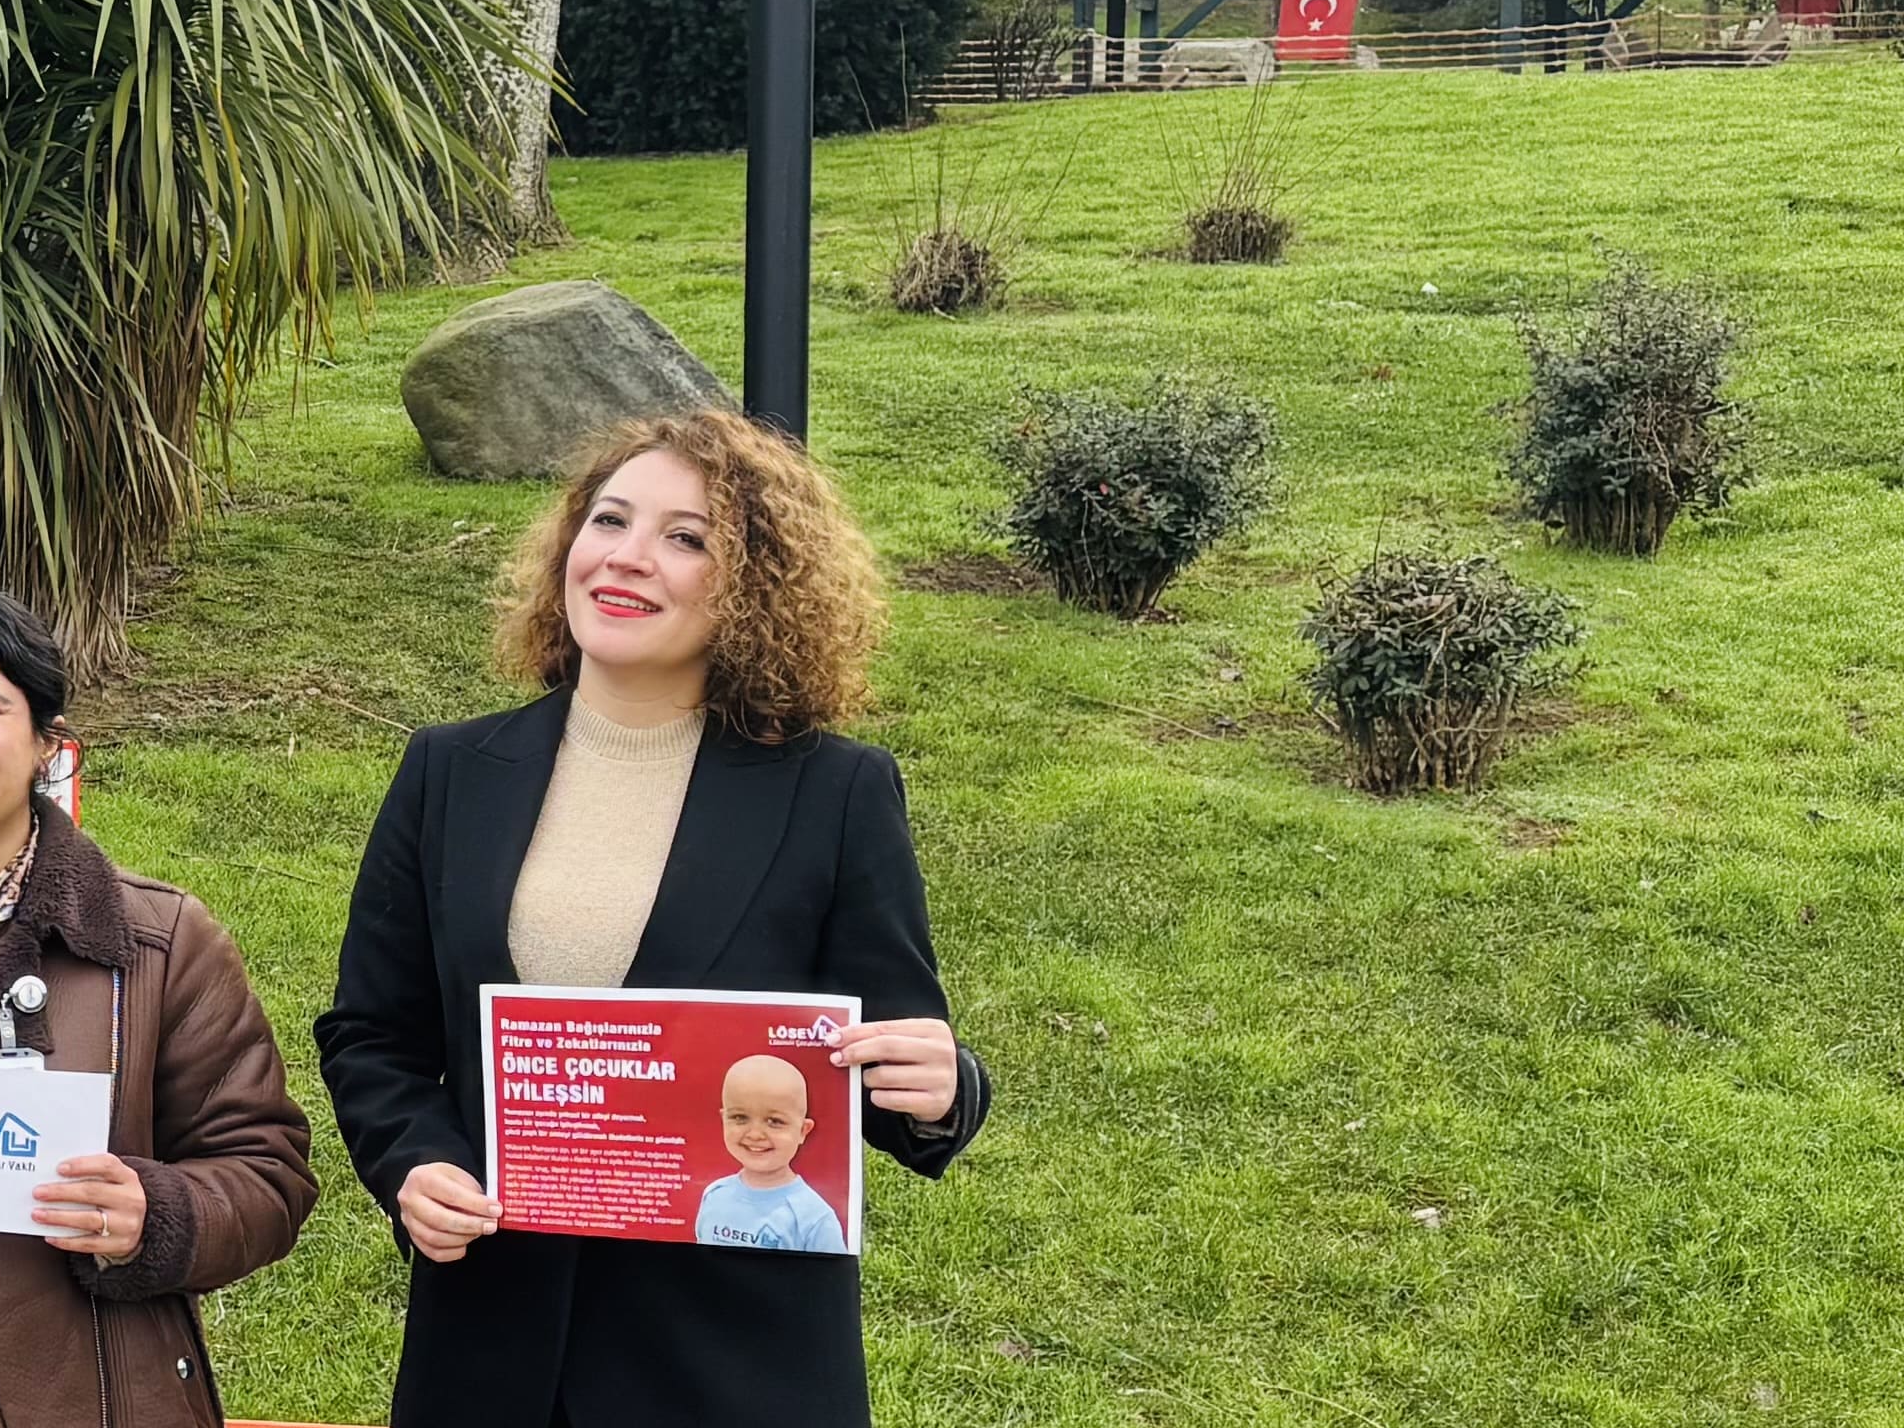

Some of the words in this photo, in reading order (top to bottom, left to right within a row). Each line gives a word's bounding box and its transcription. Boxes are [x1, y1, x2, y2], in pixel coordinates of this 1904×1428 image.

[500, 1018, 562, 1032] Ramazan
[536, 1038, 553, 1048] ve
[502, 1052, 558, 1074] ÖNCE
[565, 1057, 676, 1081] ÇOCUKLAR
[503, 1078, 605, 1107] İYİLEŞSİN
